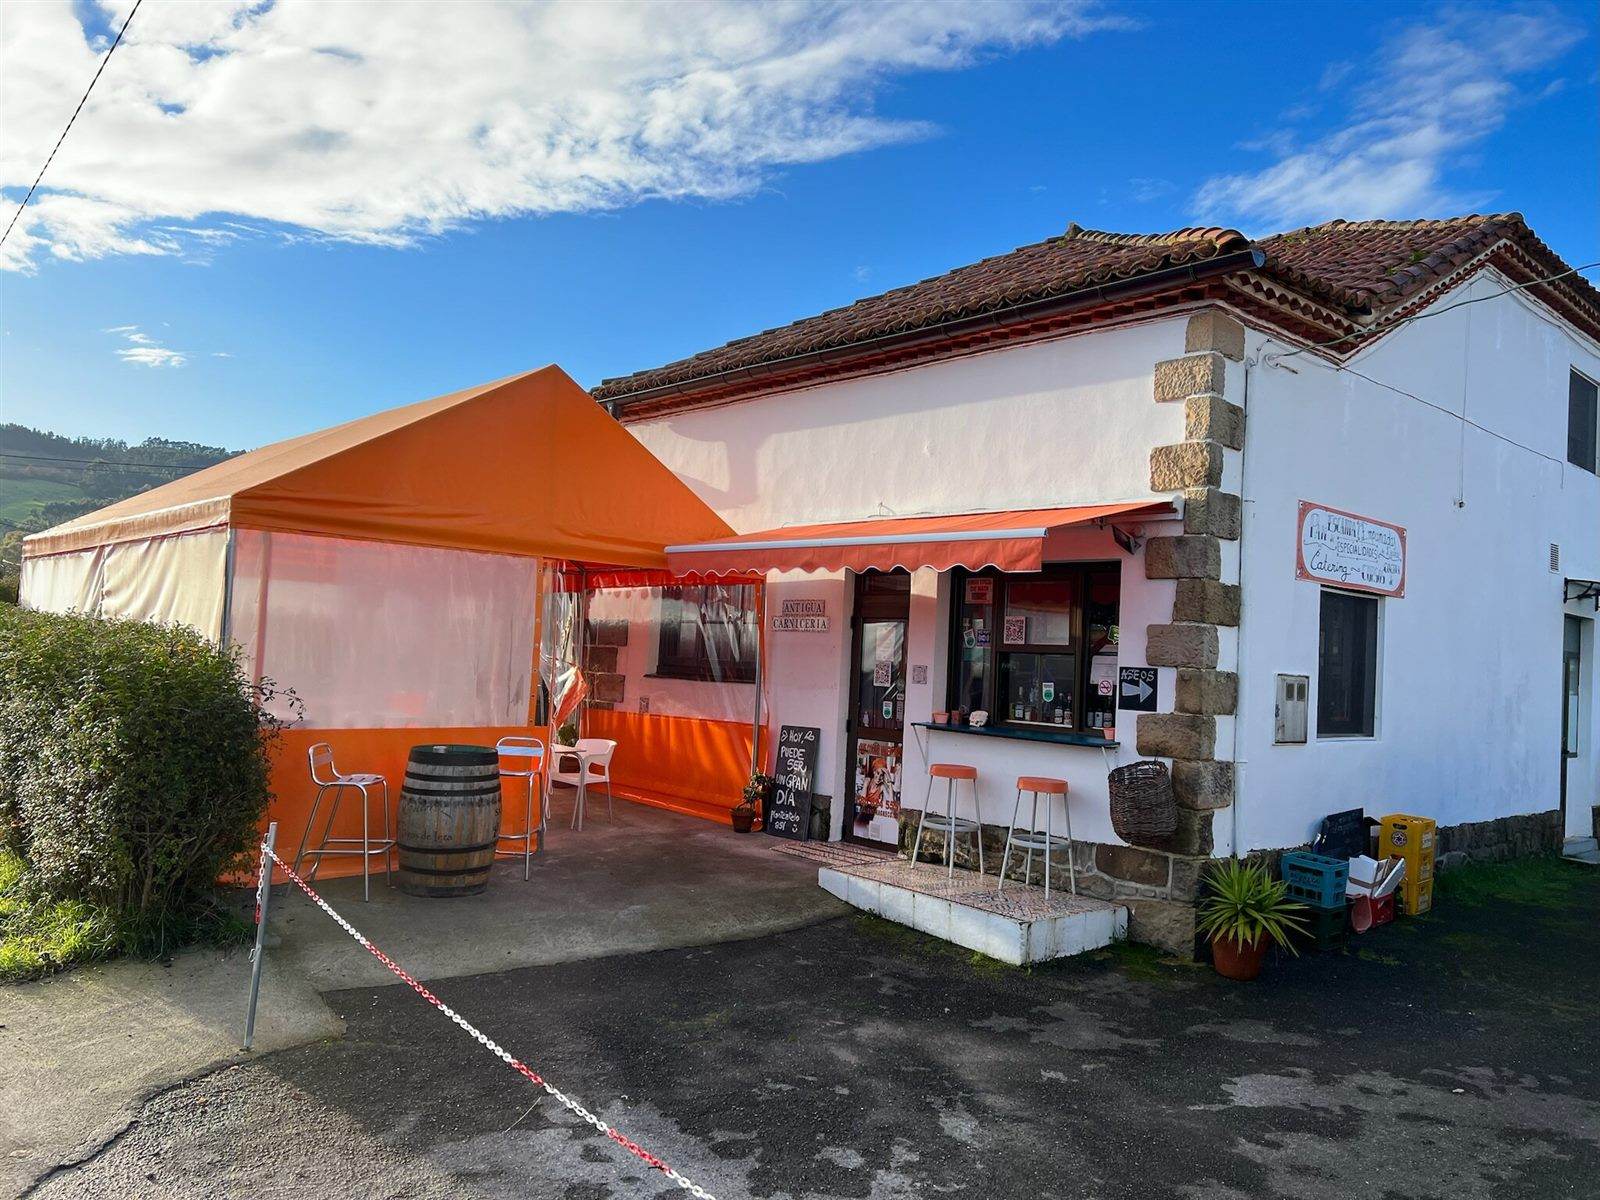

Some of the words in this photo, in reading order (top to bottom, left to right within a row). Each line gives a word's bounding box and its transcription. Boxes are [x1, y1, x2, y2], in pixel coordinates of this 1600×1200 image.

[1336, 541, 1378, 560] ESPECIALIDADES
[1310, 549, 1351, 582] Catering
[784, 602, 822, 613] ANTIGUA
[1120, 669, 1155, 682] ASEOS
[780, 746, 805, 760] PUEDE
[787, 759, 807, 773] SER
[776, 774, 786, 785] UN
[786, 774, 808, 792] GRAN
[776, 788, 795, 807] DÍA
